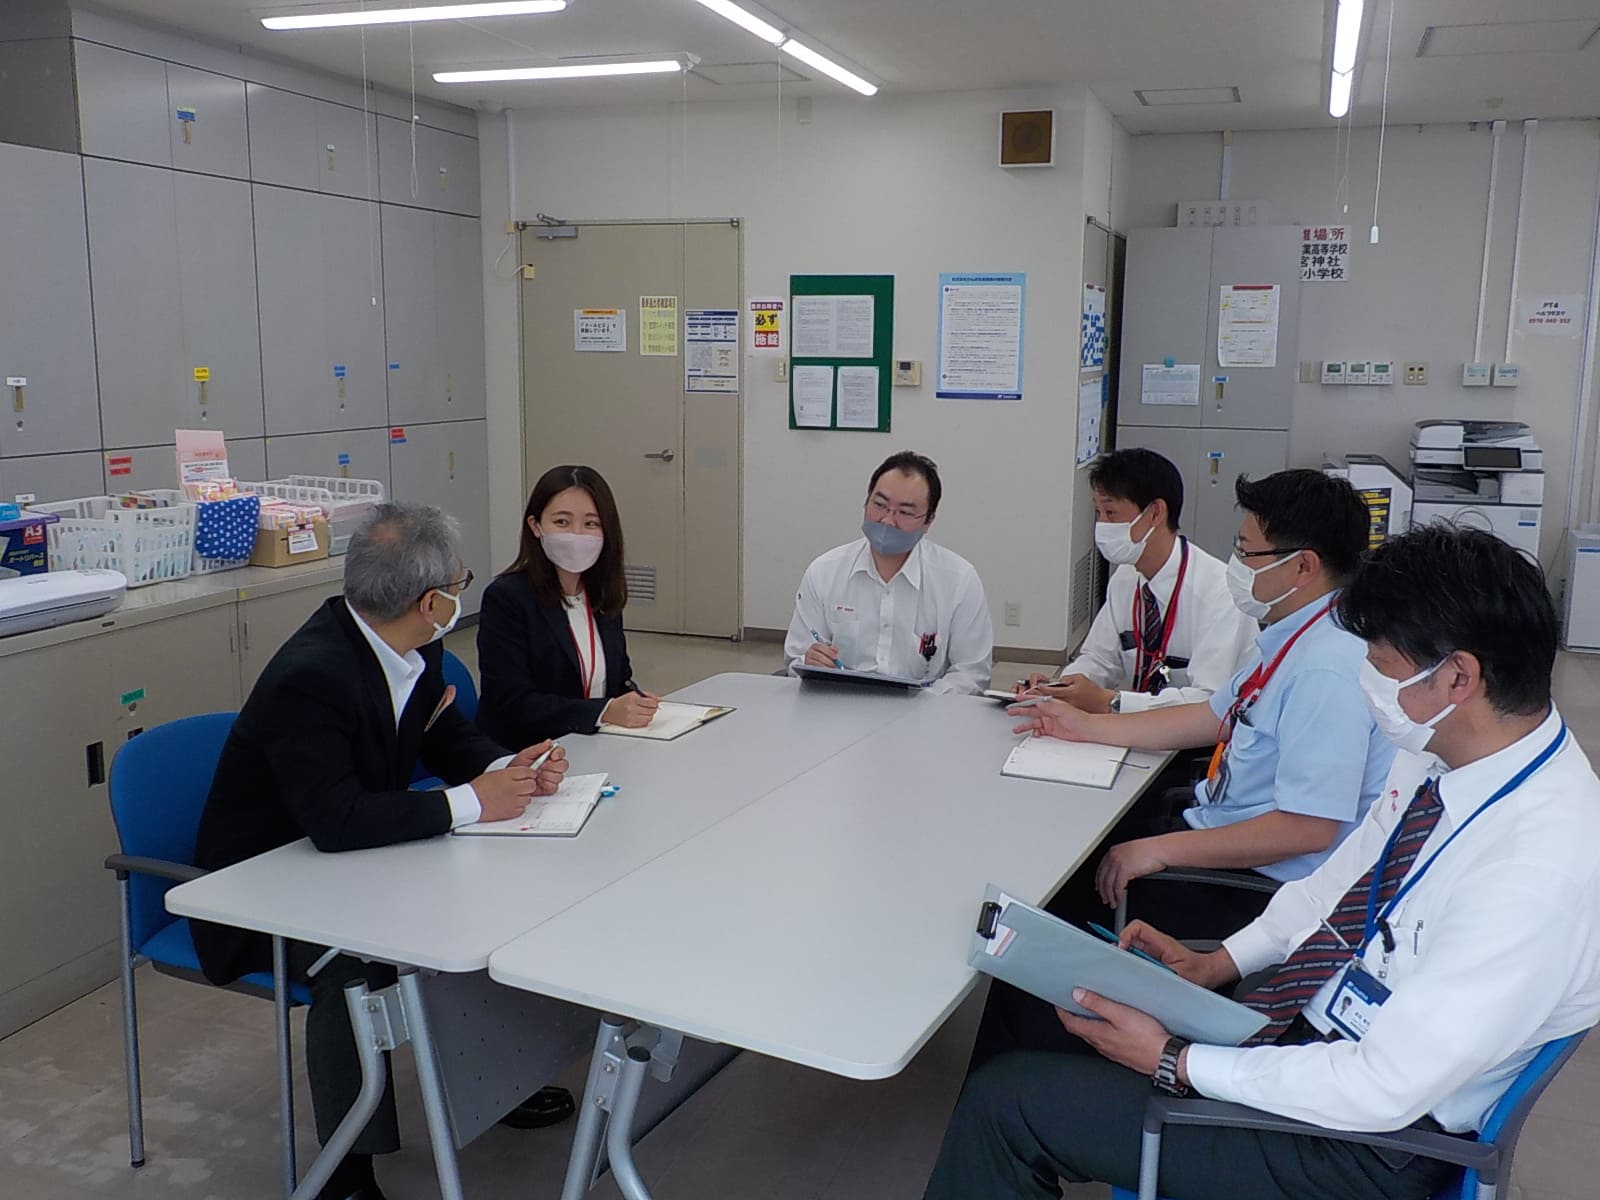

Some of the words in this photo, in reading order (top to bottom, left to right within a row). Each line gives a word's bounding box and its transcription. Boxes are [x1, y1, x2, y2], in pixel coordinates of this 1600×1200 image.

[1299, 267, 1344, 279] 小学校
[755, 313, 778, 326] 必ず
[755, 332, 778, 346] 施錠
[25, 524, 43, 537] A3
